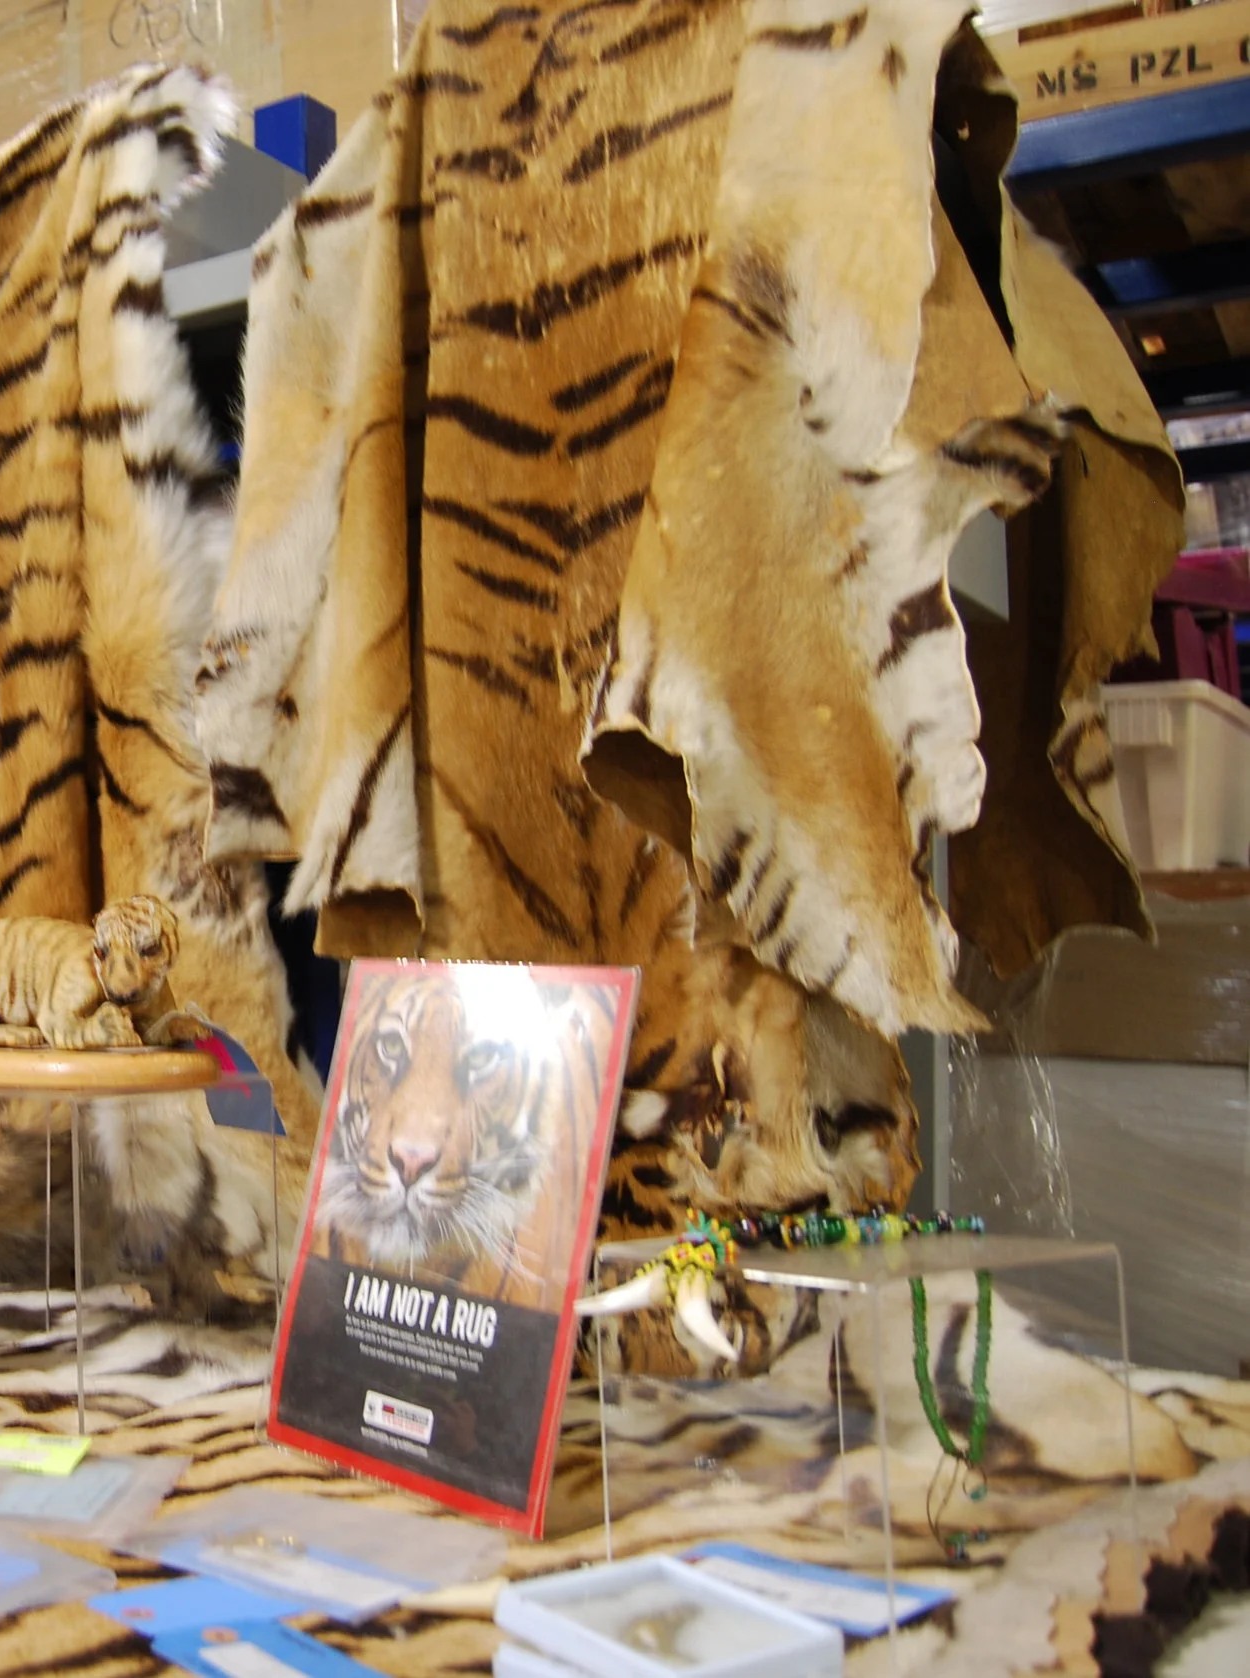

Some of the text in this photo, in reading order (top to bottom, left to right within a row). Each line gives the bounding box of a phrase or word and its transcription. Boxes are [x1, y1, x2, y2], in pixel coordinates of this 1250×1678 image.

[1036, 60, 1098, 99] MS
[1130, 44, 1212, 85] PZL
[344, 1272, 355, 1310] I
[354, 1275, 390, 1319] AM
[390, 1283, 435, 1330] NOT
[431, 1294, 449, 1336] A
[451, 1298, 497, 1348] RUG
